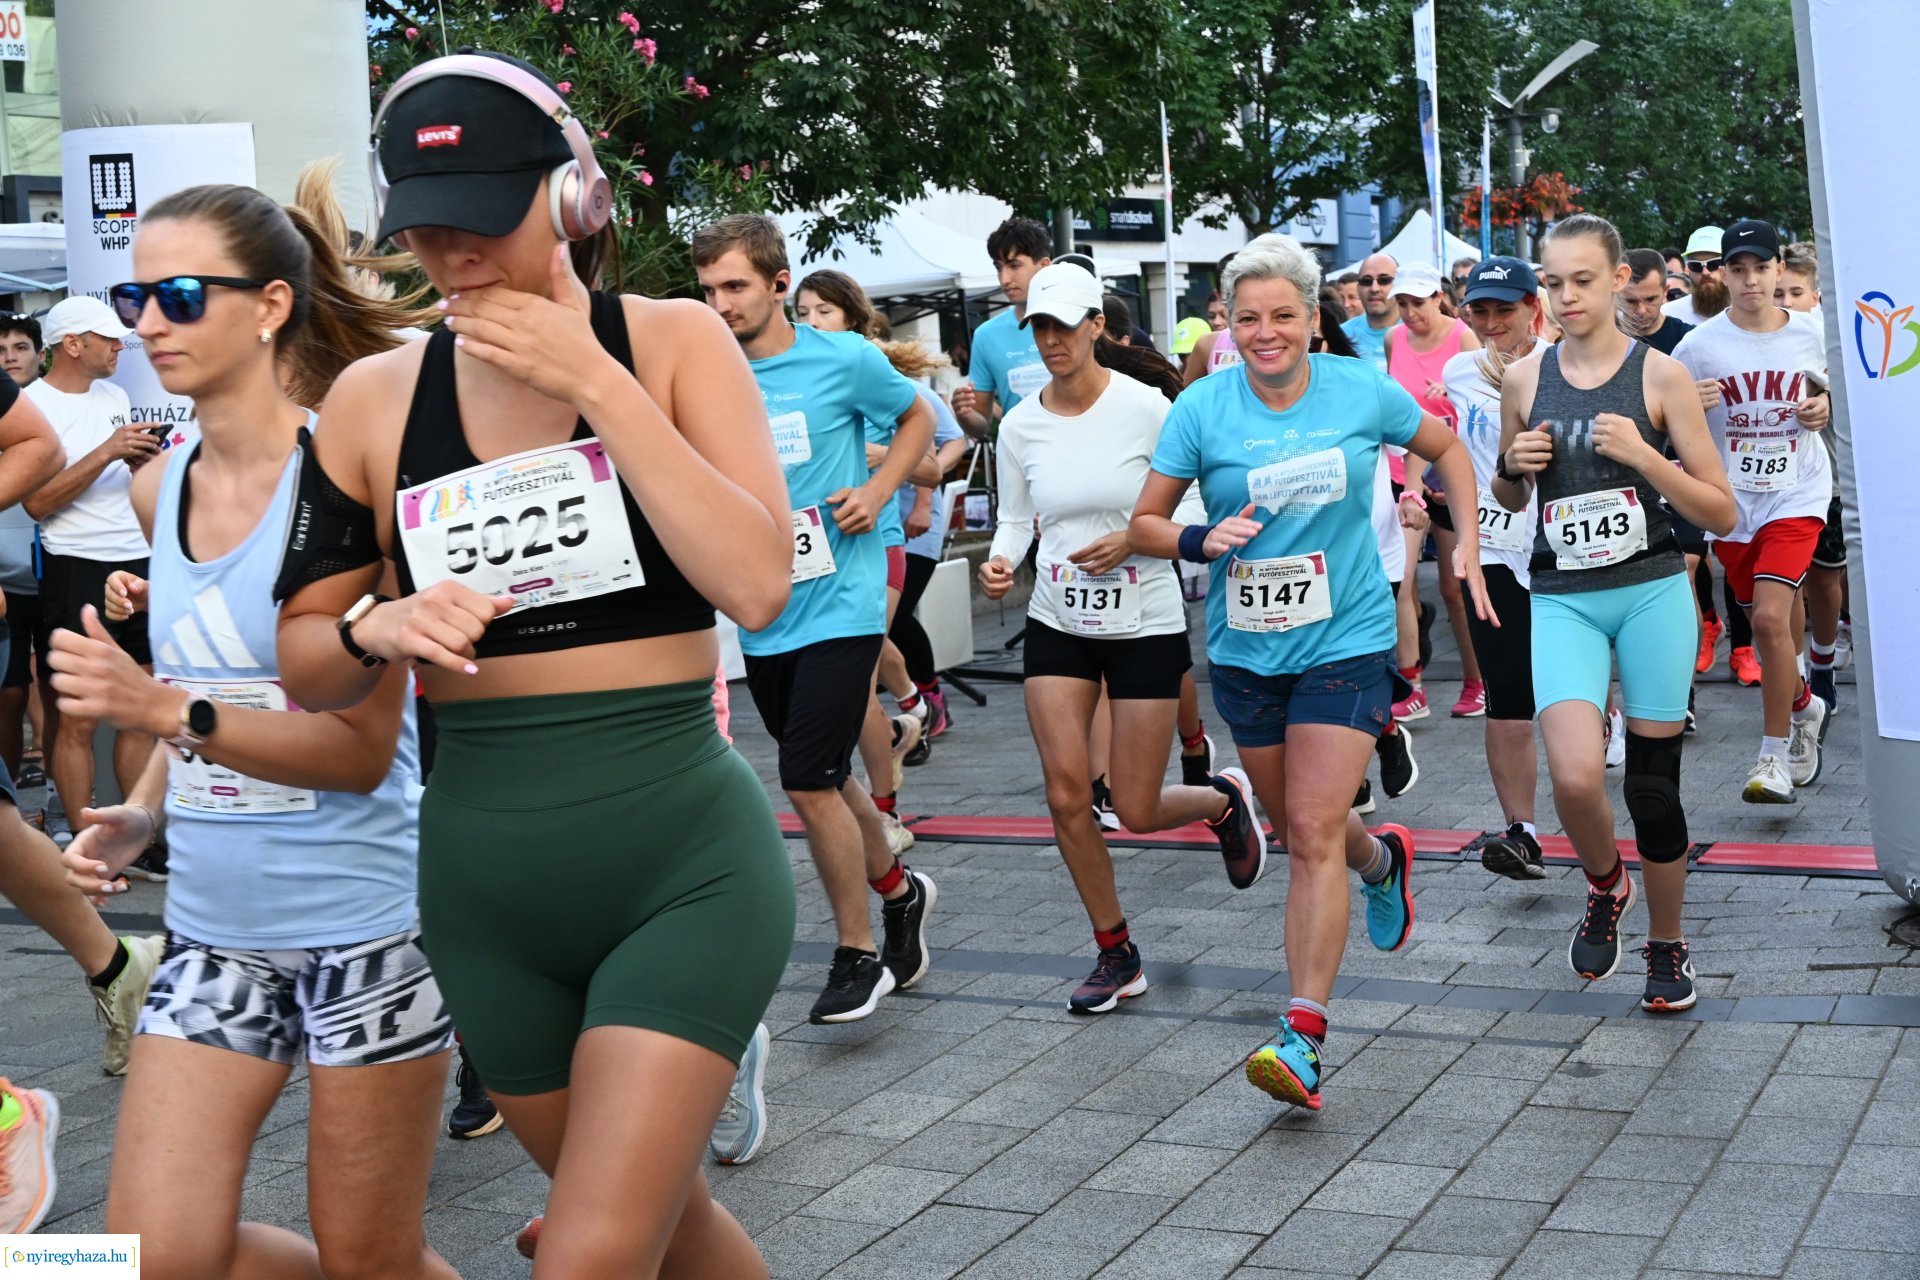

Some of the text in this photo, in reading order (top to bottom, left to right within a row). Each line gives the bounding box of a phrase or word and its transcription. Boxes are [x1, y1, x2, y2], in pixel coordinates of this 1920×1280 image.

[101, 236, 130, 250] WHP
[1479, 271, 1504, 281] PUMA
[1740, 457, 1788, 475] 5183
[483, 471, 576, 502] FUTÓFESZTIVÁL
[1478, 507, 1512, 531] 071
[1578, 501, 1623, 514] FUTÓFESZTIVÁL
[446, 495, 589, 575] 5025
[1562, 512, 1630, 546] 5143
[1259, 569, 1308, 578] FUTÓFESZTIVÁL
[1064, 587, 1122, 610] 5131
[1239, 580, 1312, 608] 5147
